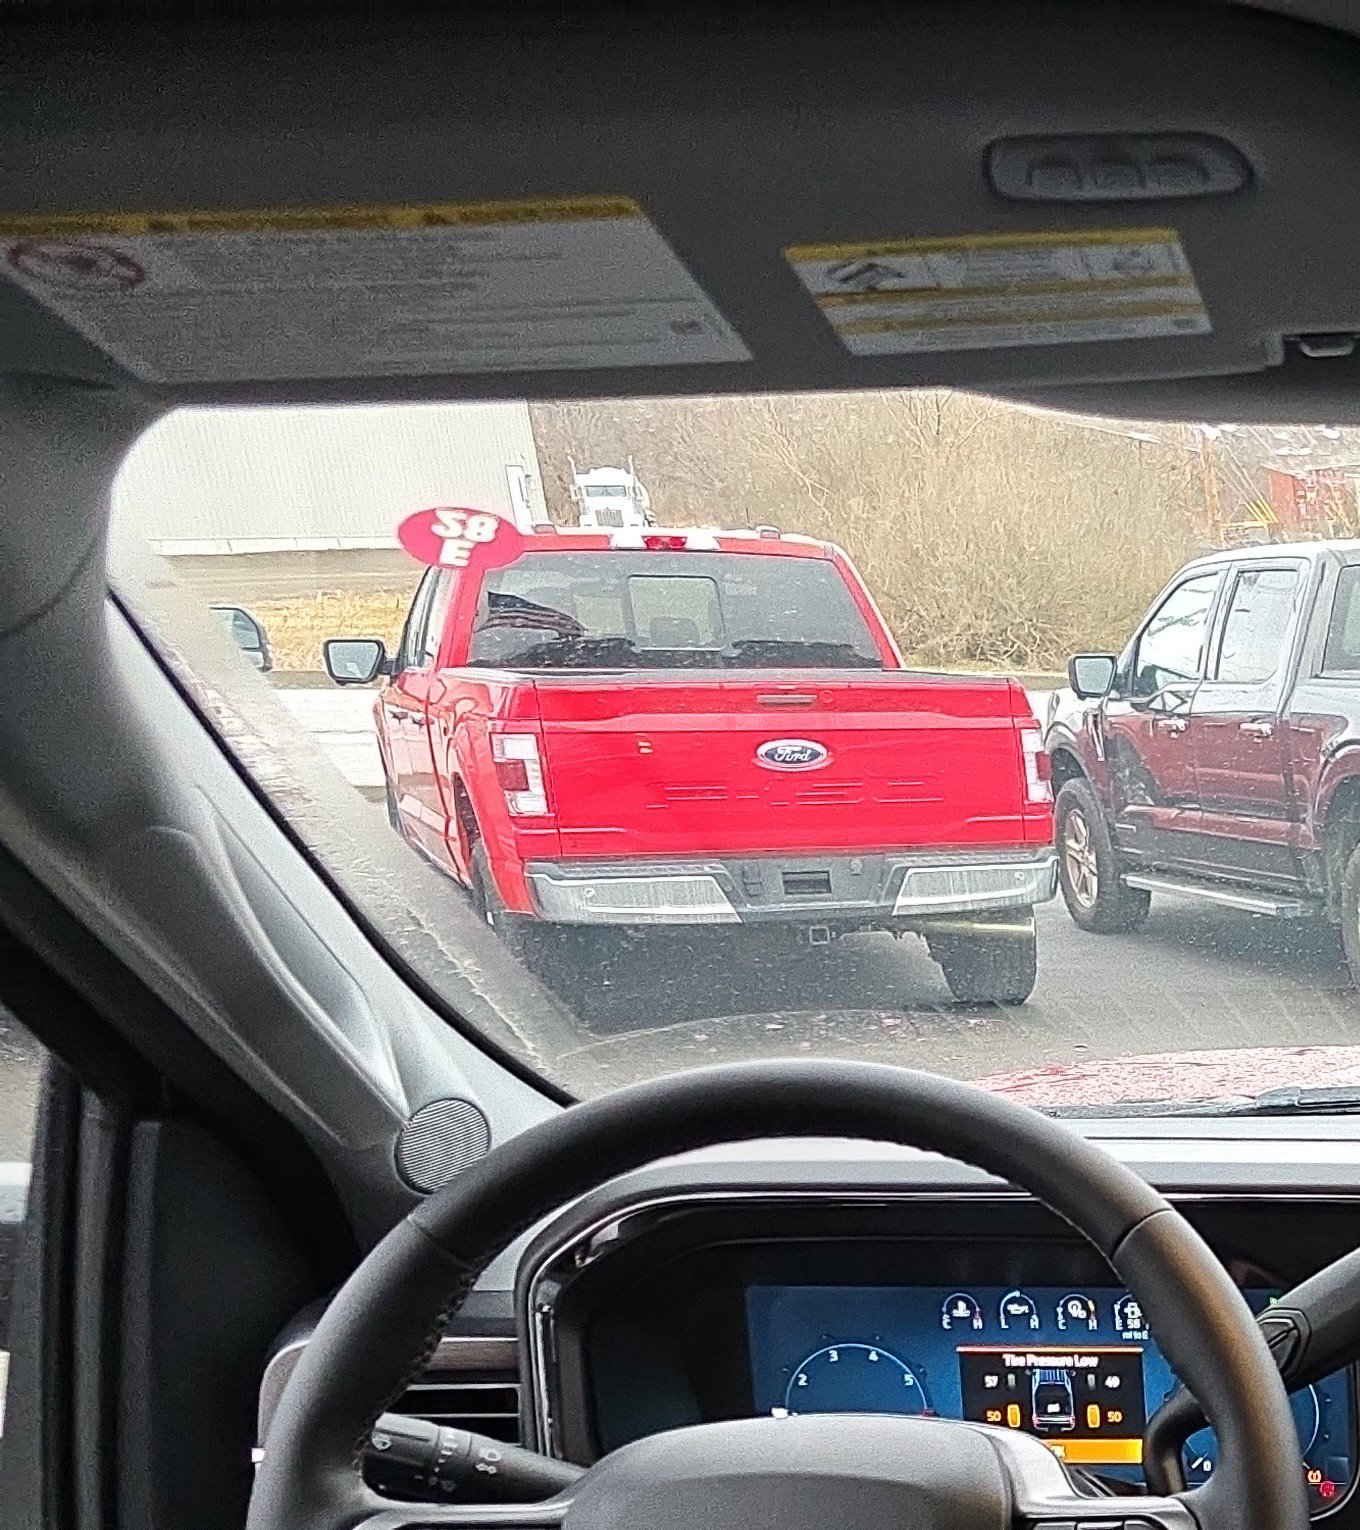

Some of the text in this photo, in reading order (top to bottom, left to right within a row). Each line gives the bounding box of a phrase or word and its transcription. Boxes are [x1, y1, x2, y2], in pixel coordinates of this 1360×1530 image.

[775, 746, 812, 762] Ford
[973, 1318, 983, 1329] H
[829, 1350, 838, 1362] 3
[868, 1350, 879, 1362] 4
[1003, 1354, 1099, 1367] Tire Pressure Low
[798, 1373, 808, 1386] 2
[904, 1373, 914, 1386] 5
[987, 1411, 1001, 1422] 50
[1108, 1412, 1122, 1422] 50
